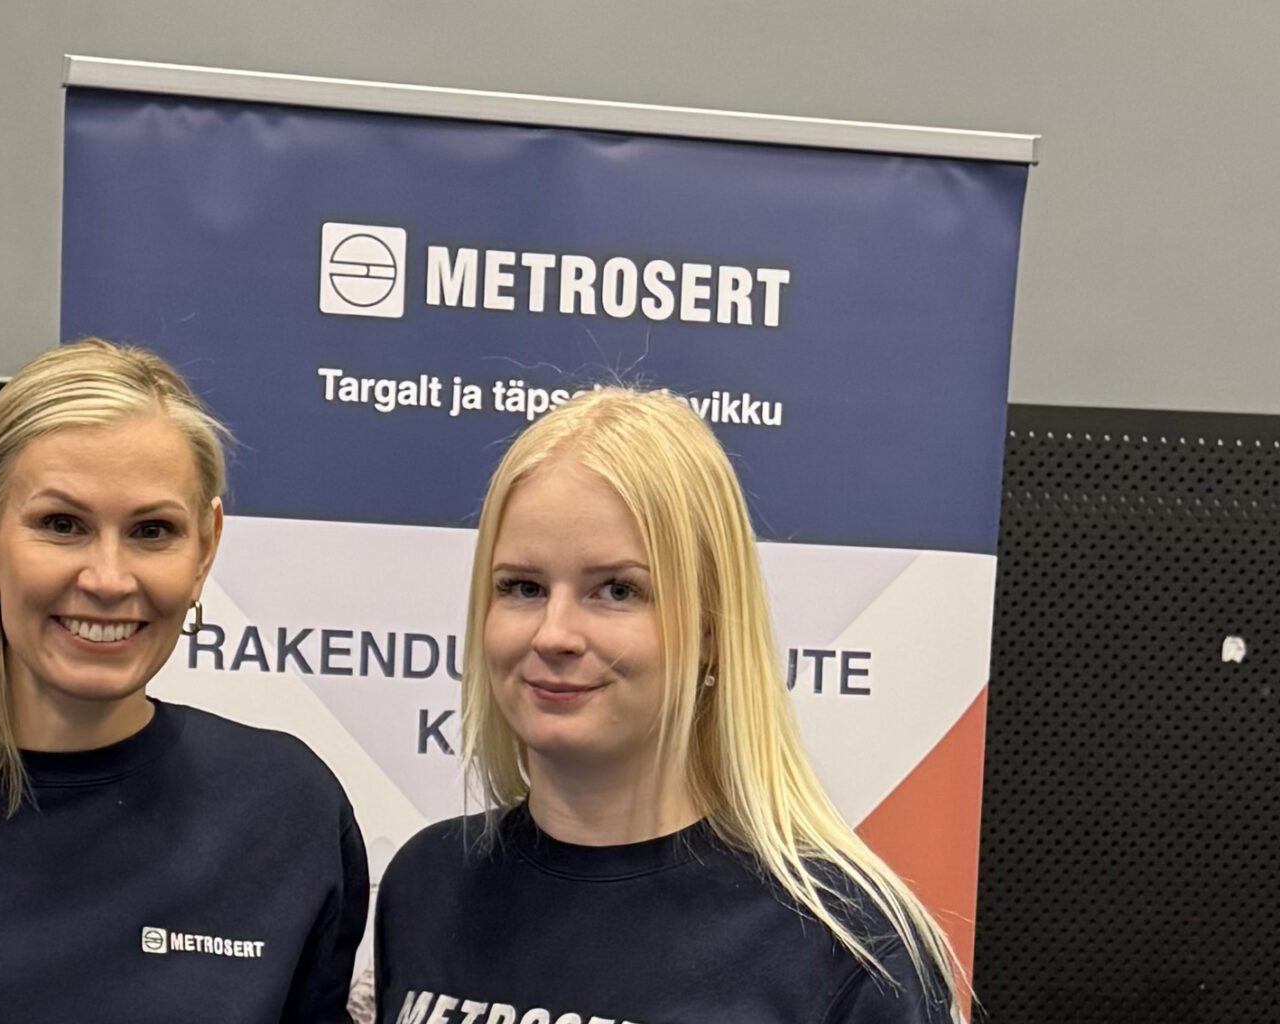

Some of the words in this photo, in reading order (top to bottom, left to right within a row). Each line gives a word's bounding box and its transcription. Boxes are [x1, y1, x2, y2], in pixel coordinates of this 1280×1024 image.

[426, 245, 791, 327] METROSERT
[318, 367, 442, 413] Targalt
[450, 376, 483, 416] ja
[492, 380, 603, 421] täps
[170, 932, 265, 959] METROSERT
